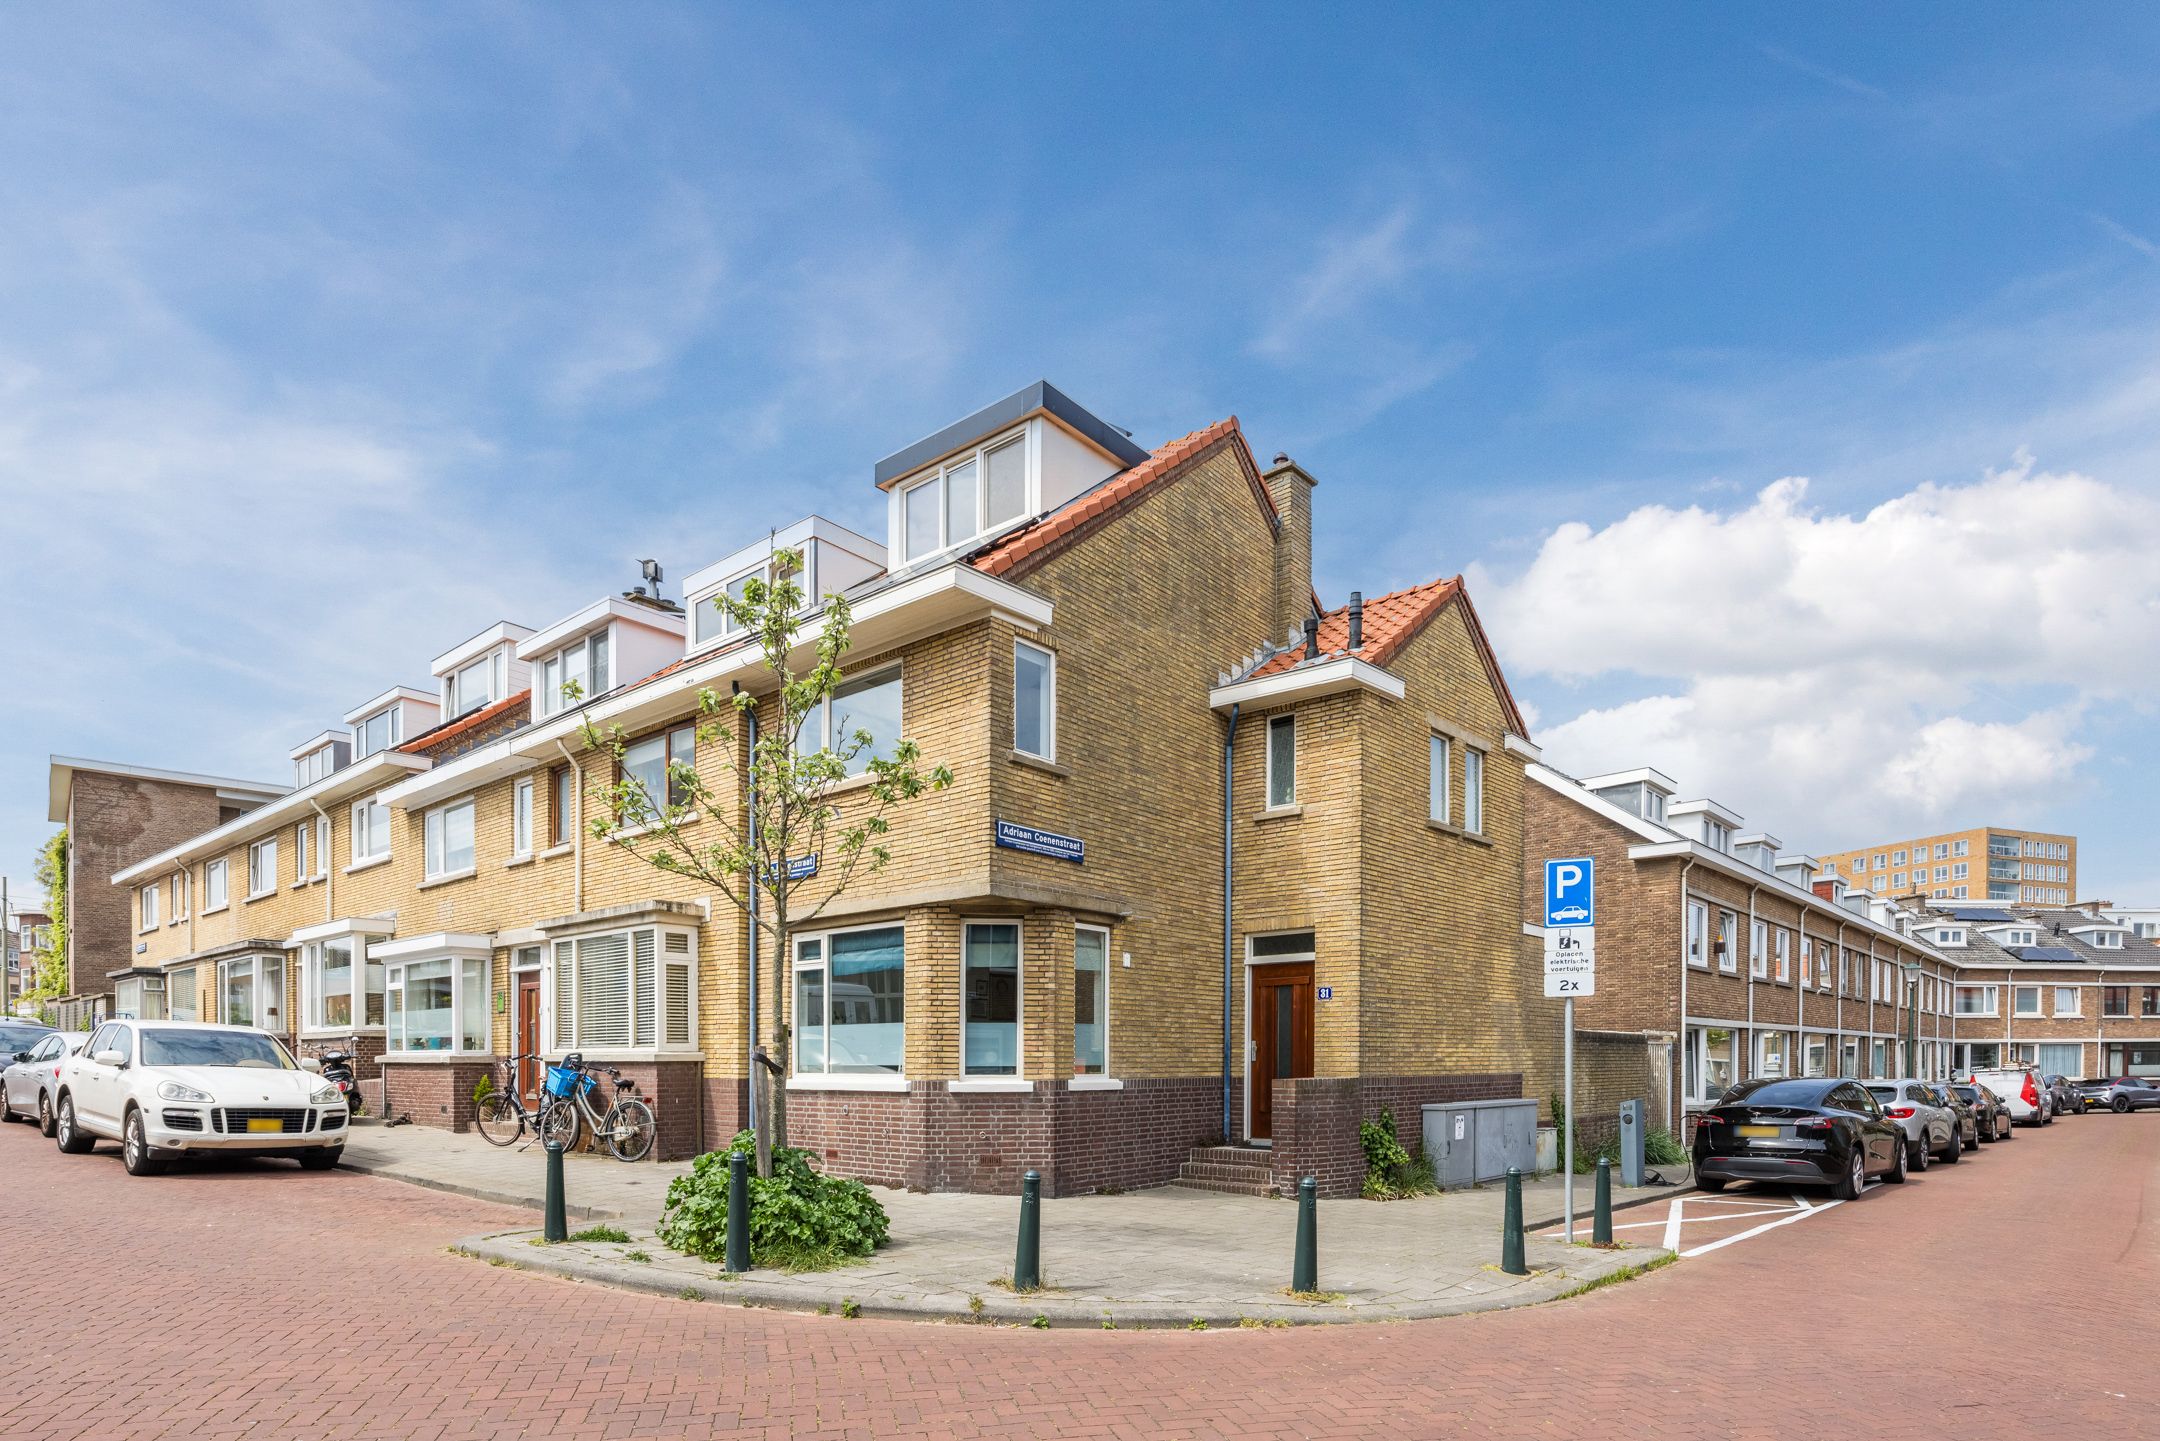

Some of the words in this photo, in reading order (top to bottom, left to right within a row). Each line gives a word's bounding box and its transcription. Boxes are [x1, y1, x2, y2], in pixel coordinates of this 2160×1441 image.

[1003, 825, 1032, 840] Adriaan
[1034, 832, 1081, 851] Coenenstraat
[1556, 865, 1583, 899] P
[1559, 979, 1579, 991] 2x
